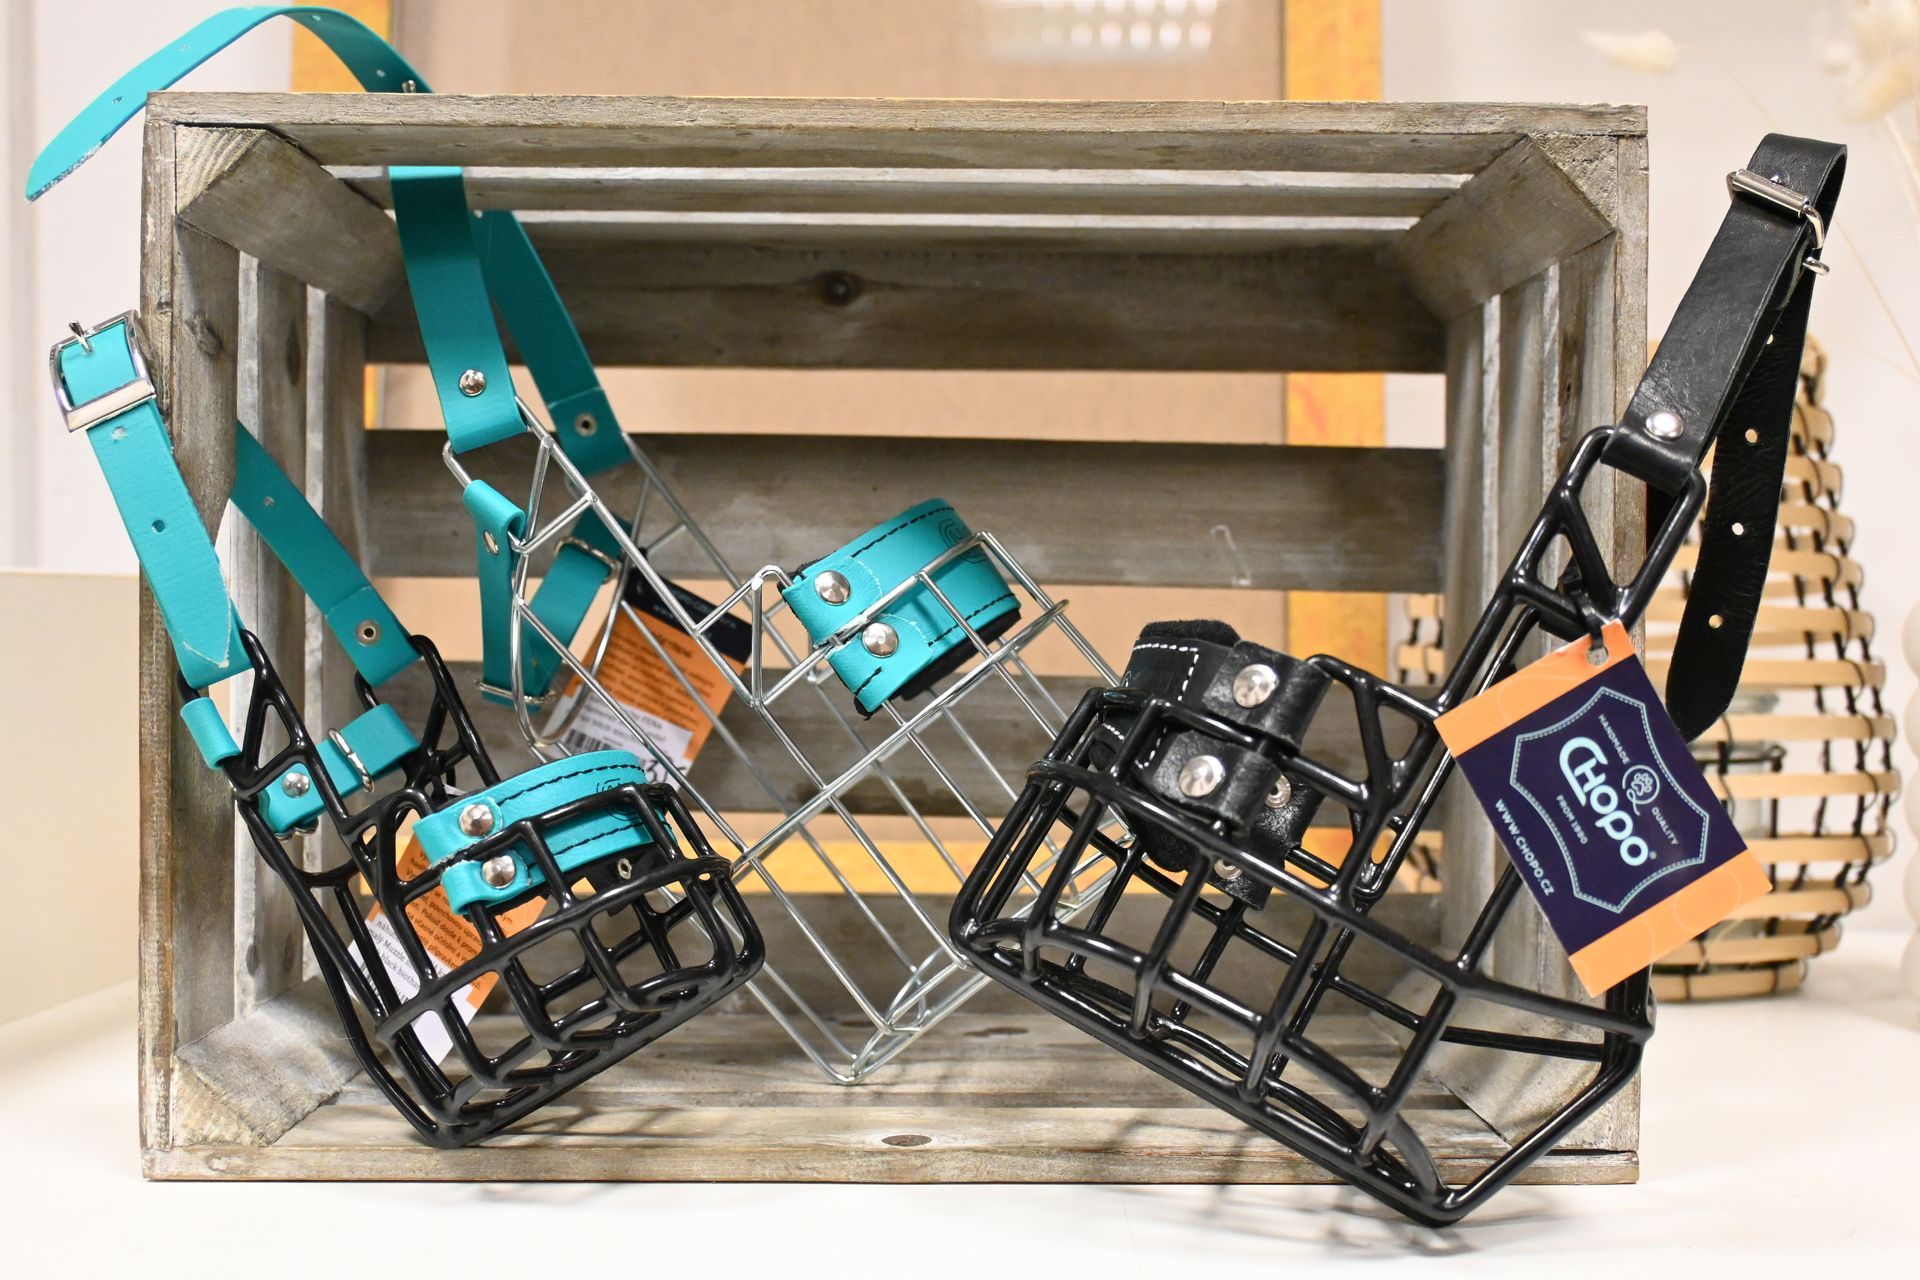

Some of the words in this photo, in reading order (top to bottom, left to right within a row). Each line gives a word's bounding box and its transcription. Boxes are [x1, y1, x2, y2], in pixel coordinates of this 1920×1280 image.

[1557, 795, 1575, 821] FROM
[1559, 737, 1651, 867] CHOPO
[1599, 714, 1630, 764] HANDMADE
[1652, 807, 1678, 844] QUALITY
[1496, 799, 1554, 896] WWW.CHOPO.CZ
[422, 908, 440, 926] Pokud
[384, 939, 406, 962] Muzzle
